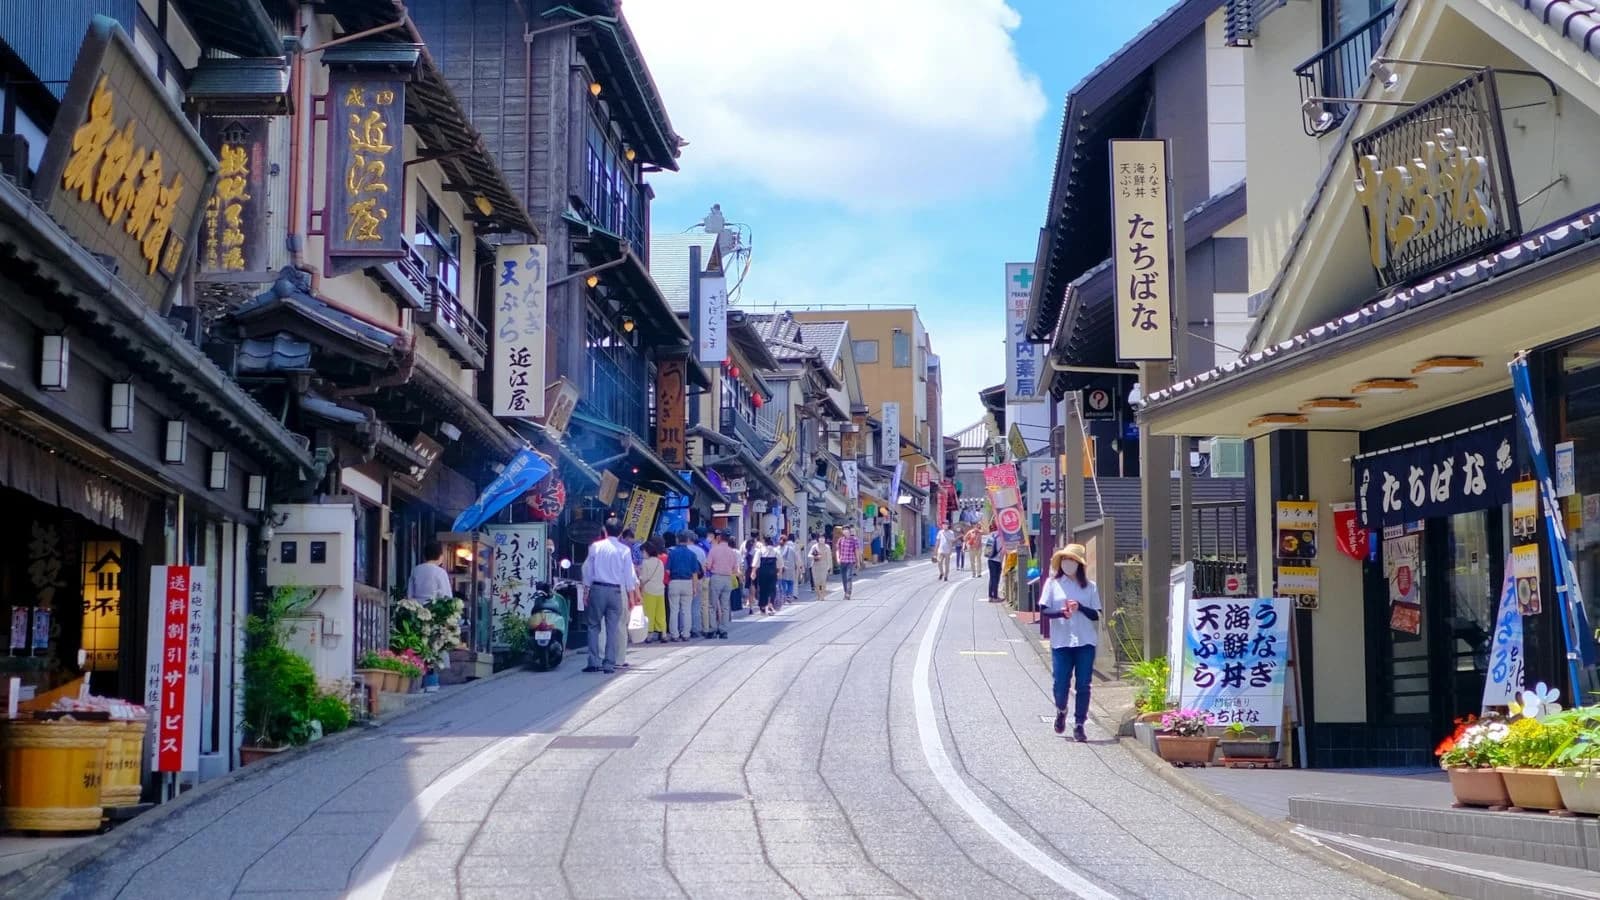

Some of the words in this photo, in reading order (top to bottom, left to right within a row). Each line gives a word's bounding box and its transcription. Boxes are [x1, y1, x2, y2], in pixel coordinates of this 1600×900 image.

[345, 110, 394, 242] 近江屋
[1119, 163, 1131, 199] 天ぷら
[1133, 163, 1146, 199] 海鮮丼
[1148, 163, 1159, 199] うなぎ
[523, 247, 541, 335] うなぎ
[1127, 213, 1159, 332] たちばな
[508, 346, 532, 411] 近江屋
[1382, 451, 1487, 513] たちばな
[162, 576, 187, 752] 送料割引サービス
[1193, 604, 1221, 687] 天ぷら
[1221, 603, 1250, 687] 海鮮丼
[1250, 604, 1278, 687] うなぎ
